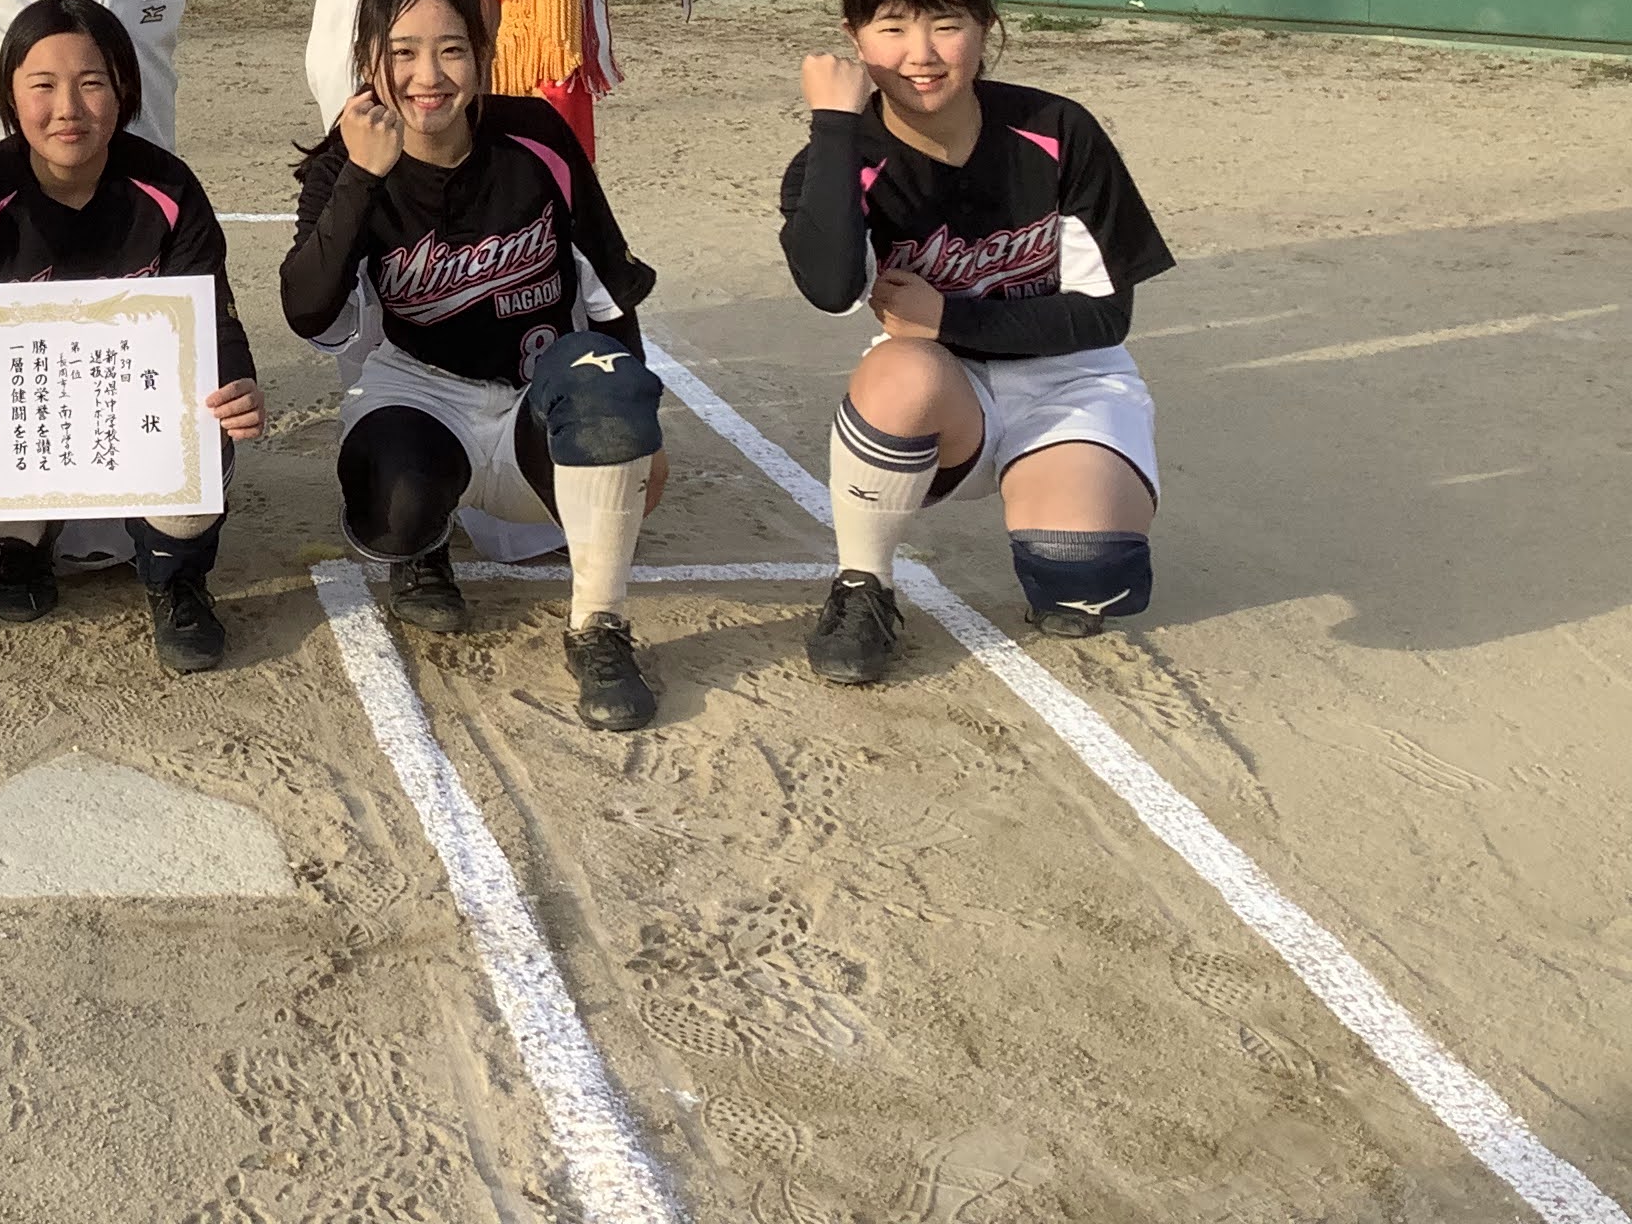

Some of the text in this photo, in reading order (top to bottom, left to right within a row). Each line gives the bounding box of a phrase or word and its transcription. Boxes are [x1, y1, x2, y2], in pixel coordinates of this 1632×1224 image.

[378, 201, 558, 300] Minami
[9, 345, 28, 471] 一層の健闘を祈る
[140, 369, 162, 434] 賞状
